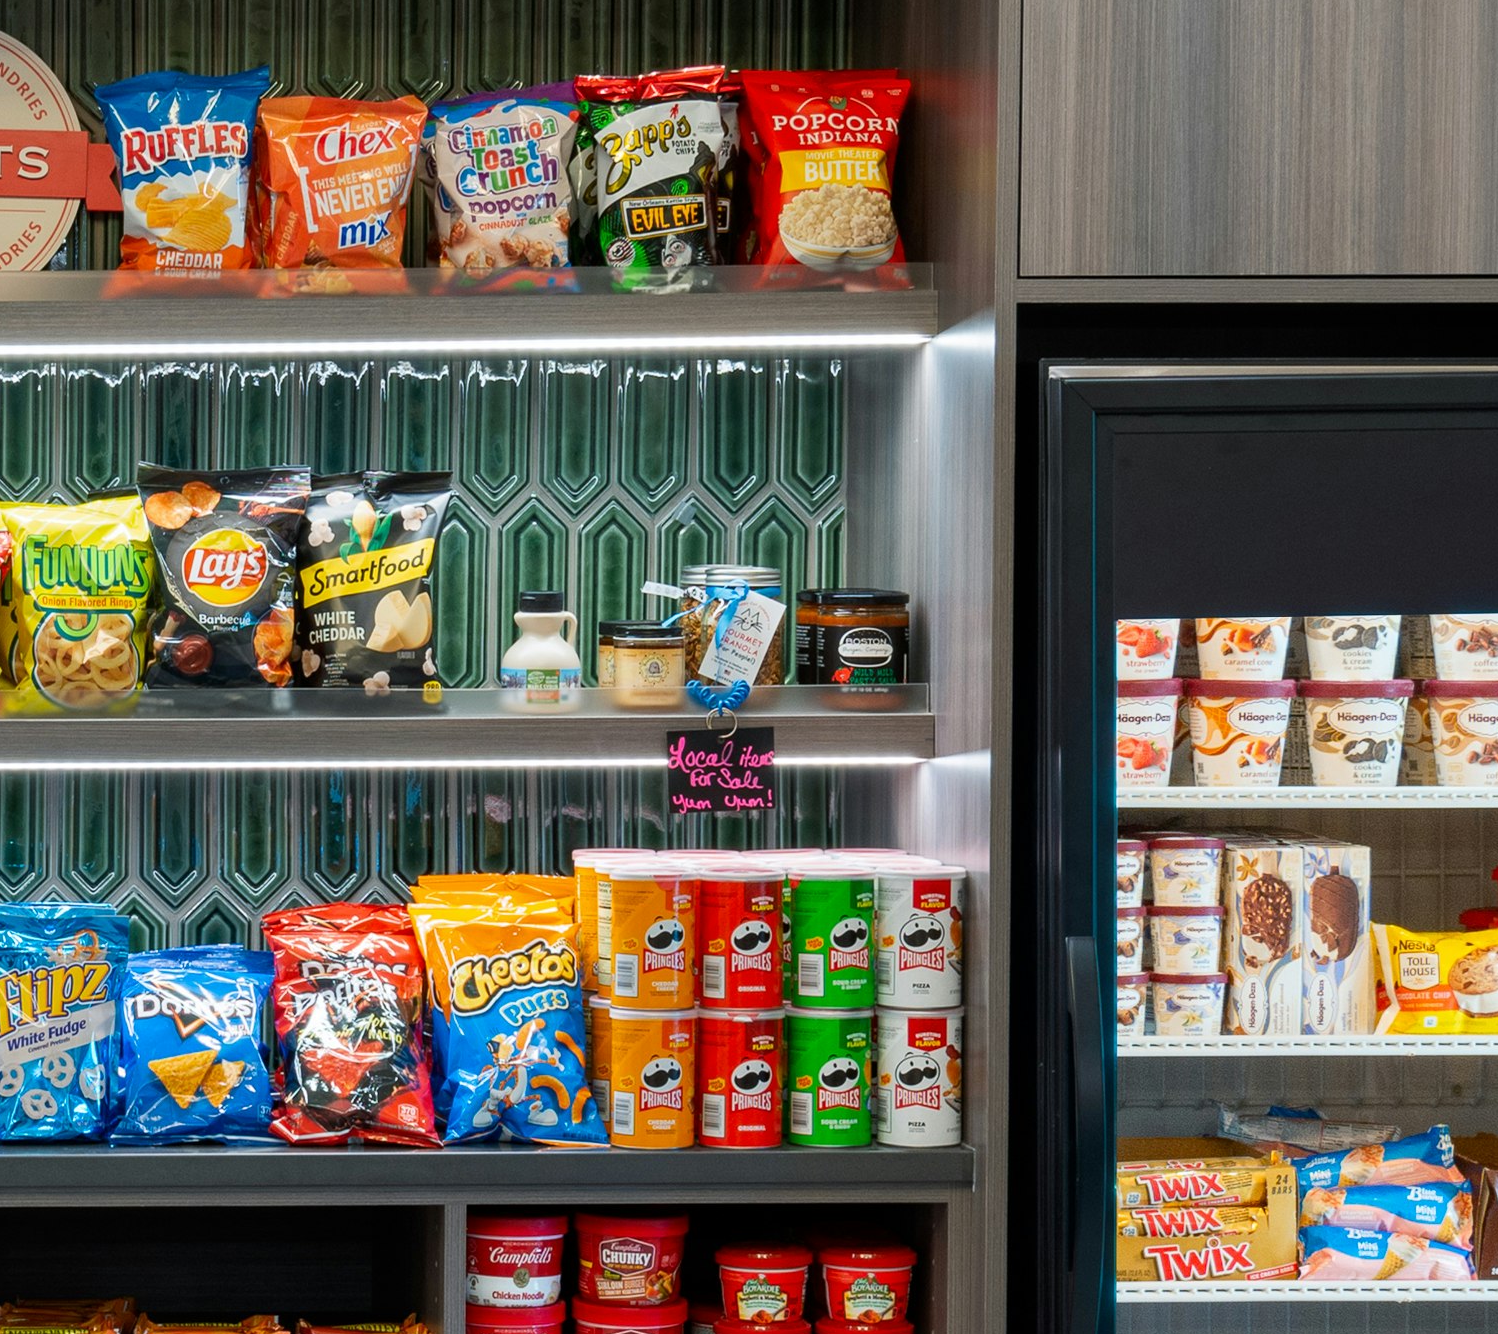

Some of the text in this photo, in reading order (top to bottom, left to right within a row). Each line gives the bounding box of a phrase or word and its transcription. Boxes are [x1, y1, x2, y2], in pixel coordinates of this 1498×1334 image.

[447, 116, 558, 154] Cinnamon
[772, 113, 901, 133] POPCORN
[122, 121, 248, 175] RUFFLES
[315, 119, 402, 165] Chex
[799, 129, 884, 145] INDIANA
[471, 141, 540, 171] Toast
[600, 115, 693, 195] Zapp's
[805, 150, 879, 161] MOVIE THEATER
[457, 153, 561, 197] Crunch
[804, 160, 881, 183] BUTTER
[469, 192, 557, 223] popcorn
[632, 205, 699, 232] EVIL EYE
[338, 211, 392, 249] mix
[156, 250, 223, 269] CHEDDAR
[23, 534, 151, 597] FUNYUNS
[188, 549, 265, 590] Lay's
[309, 552, 427, 597] Smartfood
[42, 596, 133, 610] Onion Flavored Rings
[314, 611, 356, 627] WHITE
[309, 628, 365, 645] CHEDDAR
[1337, 711, 1398, 724] Häagen-Dazs
[668, 736, 775, 768] Local items
[717, 768, 764, 790] Sale
[643, 950, 685, 972] PRINGLES
[730, 950, 772, 972] PRINGLES
[1402, 967, 1436, 977] HOUSE
[1406, 957, 1431, 966] TOLL
[452, 939, 576, 1012] Cheetos
[136, 991, 256, 1019] Doritos
[500, 989, 568, 1025] PUFFS
[6, 1016, 87, 1053] White Fudge
[1272, 1185, 1292, 1195] BARS
[1275, 1174, 1289, 1185] 24
[602, 1249, 652, 1267] CHUNKY
